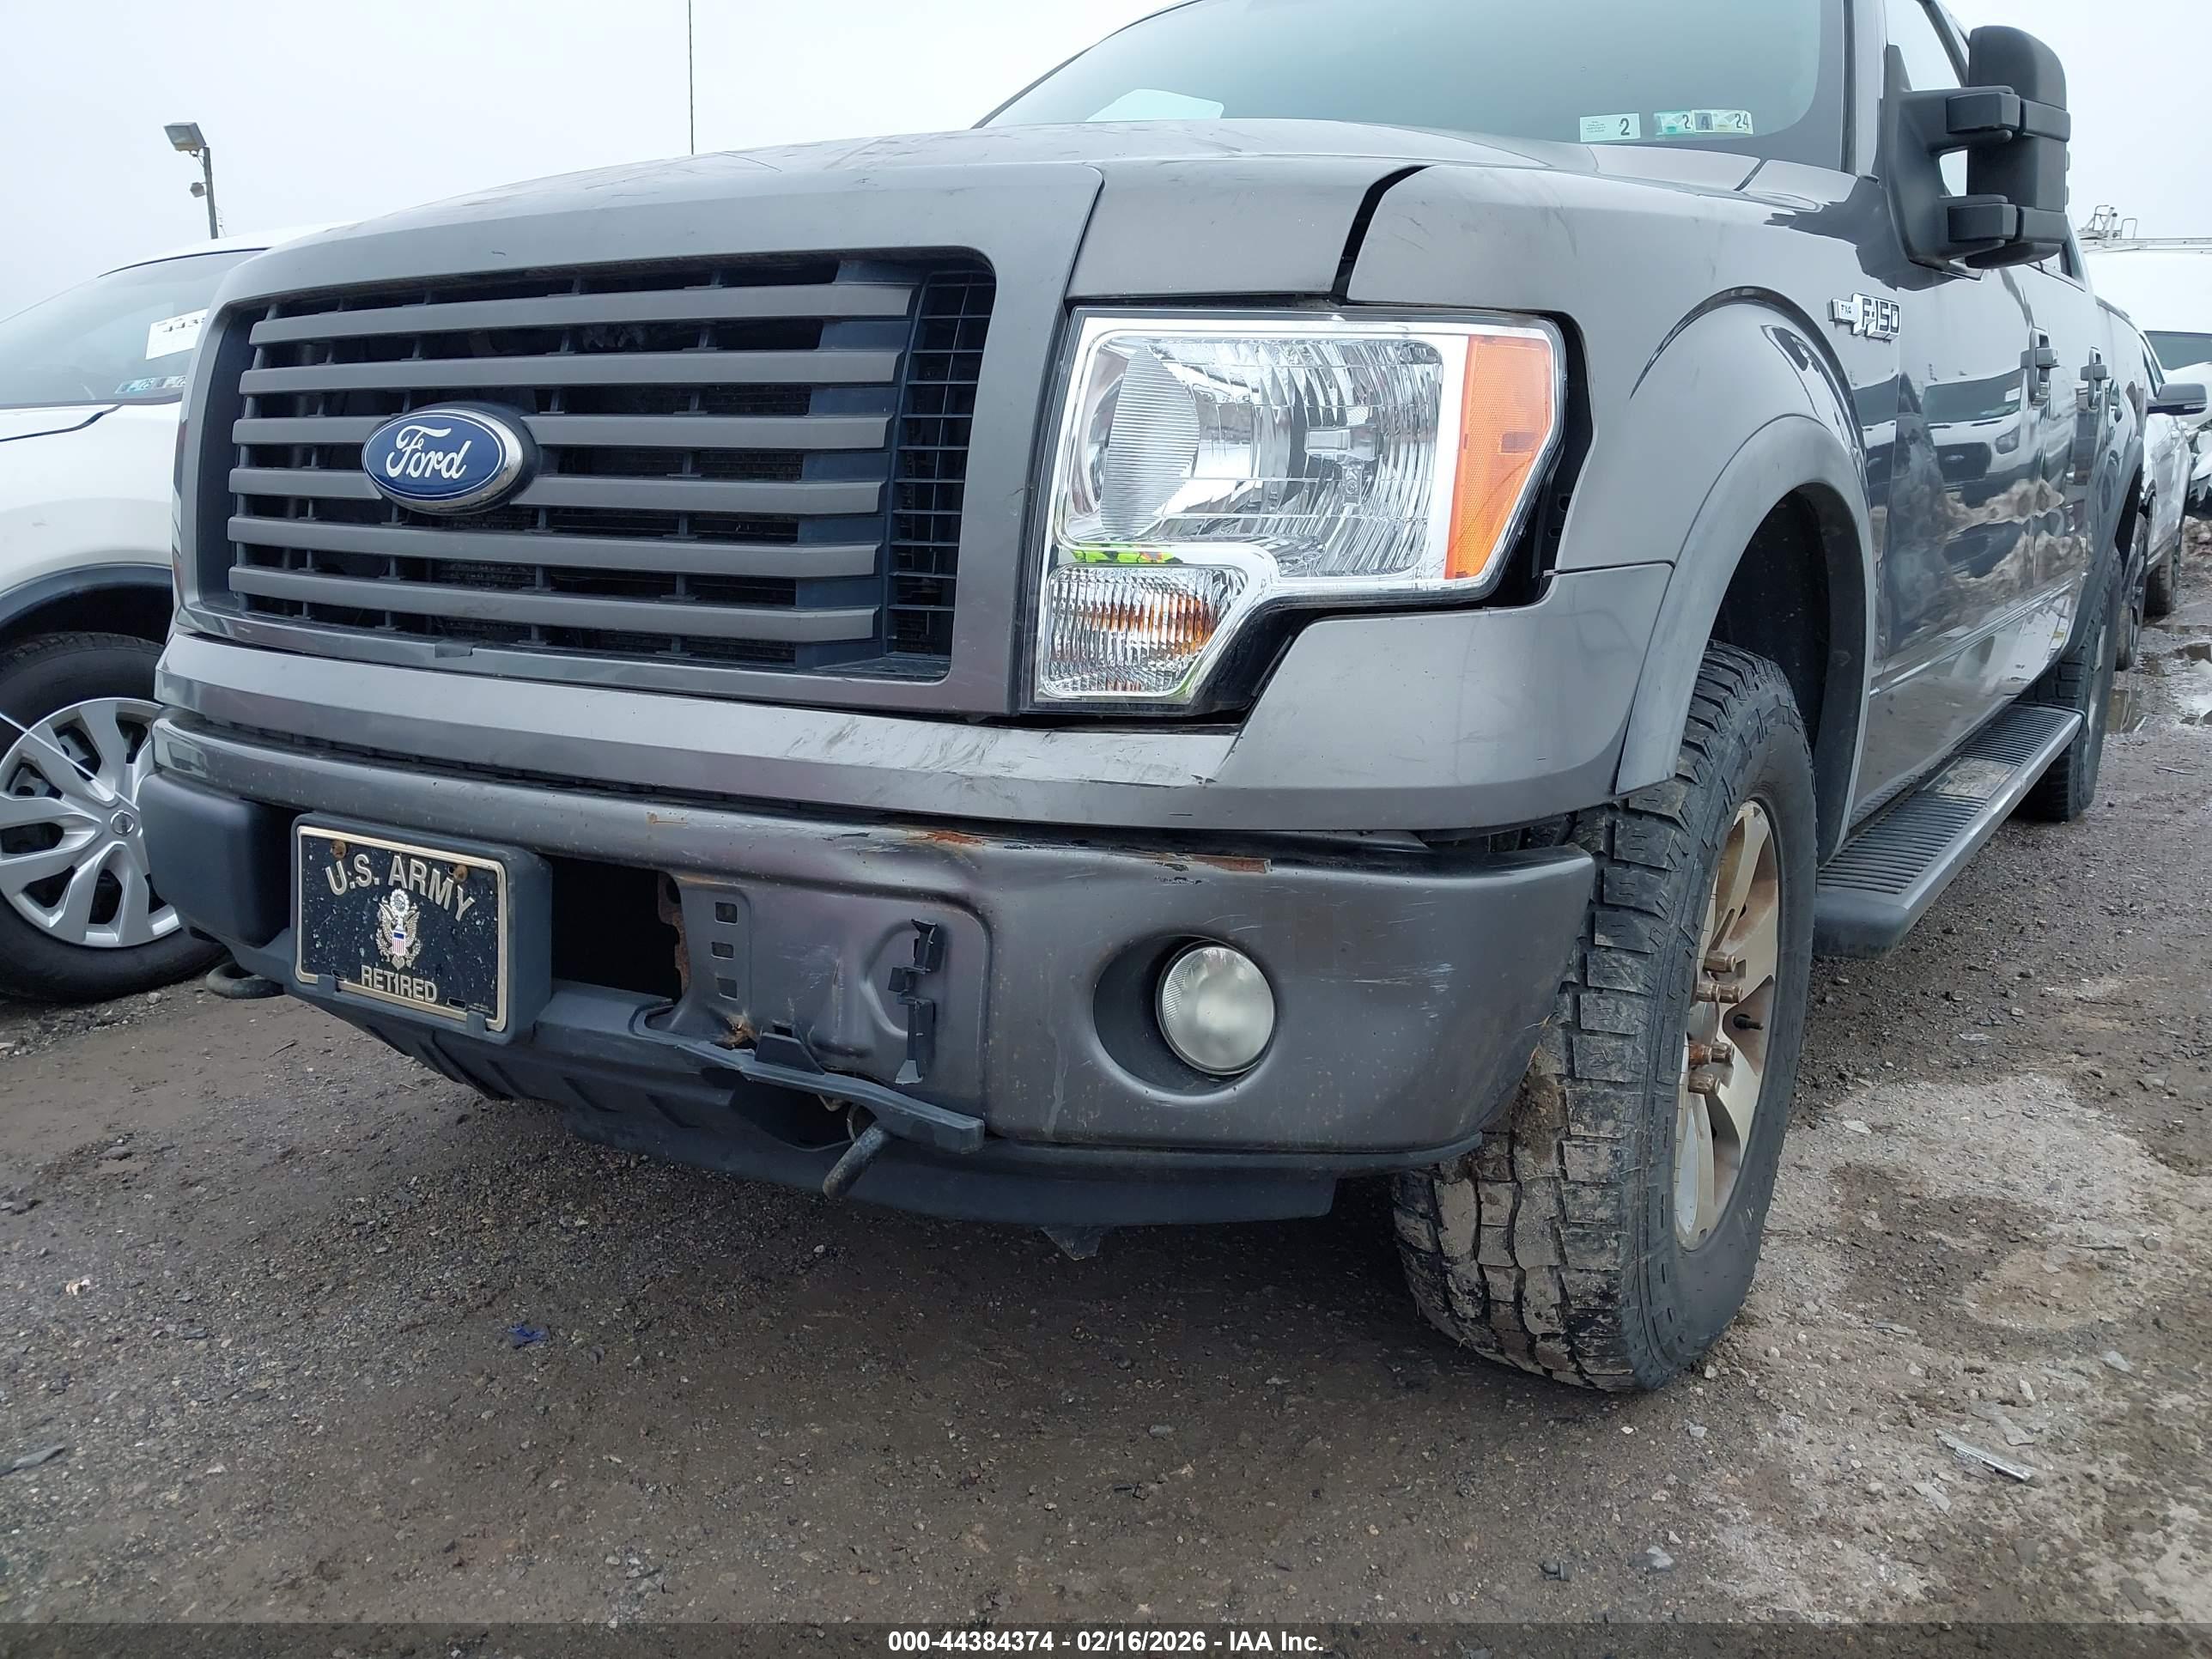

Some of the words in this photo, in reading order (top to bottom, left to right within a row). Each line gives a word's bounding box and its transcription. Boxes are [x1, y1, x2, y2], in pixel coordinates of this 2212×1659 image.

[1620, 118, 1630, 136] 2
[1735, 113, 1750, 129] 24
[386, 425, 472, 479] Ford
[325, 854, 380, 896] U.S.
[387, 855, 476, 921] ARMY
[361, 964, 438, 1003] RETIRED
